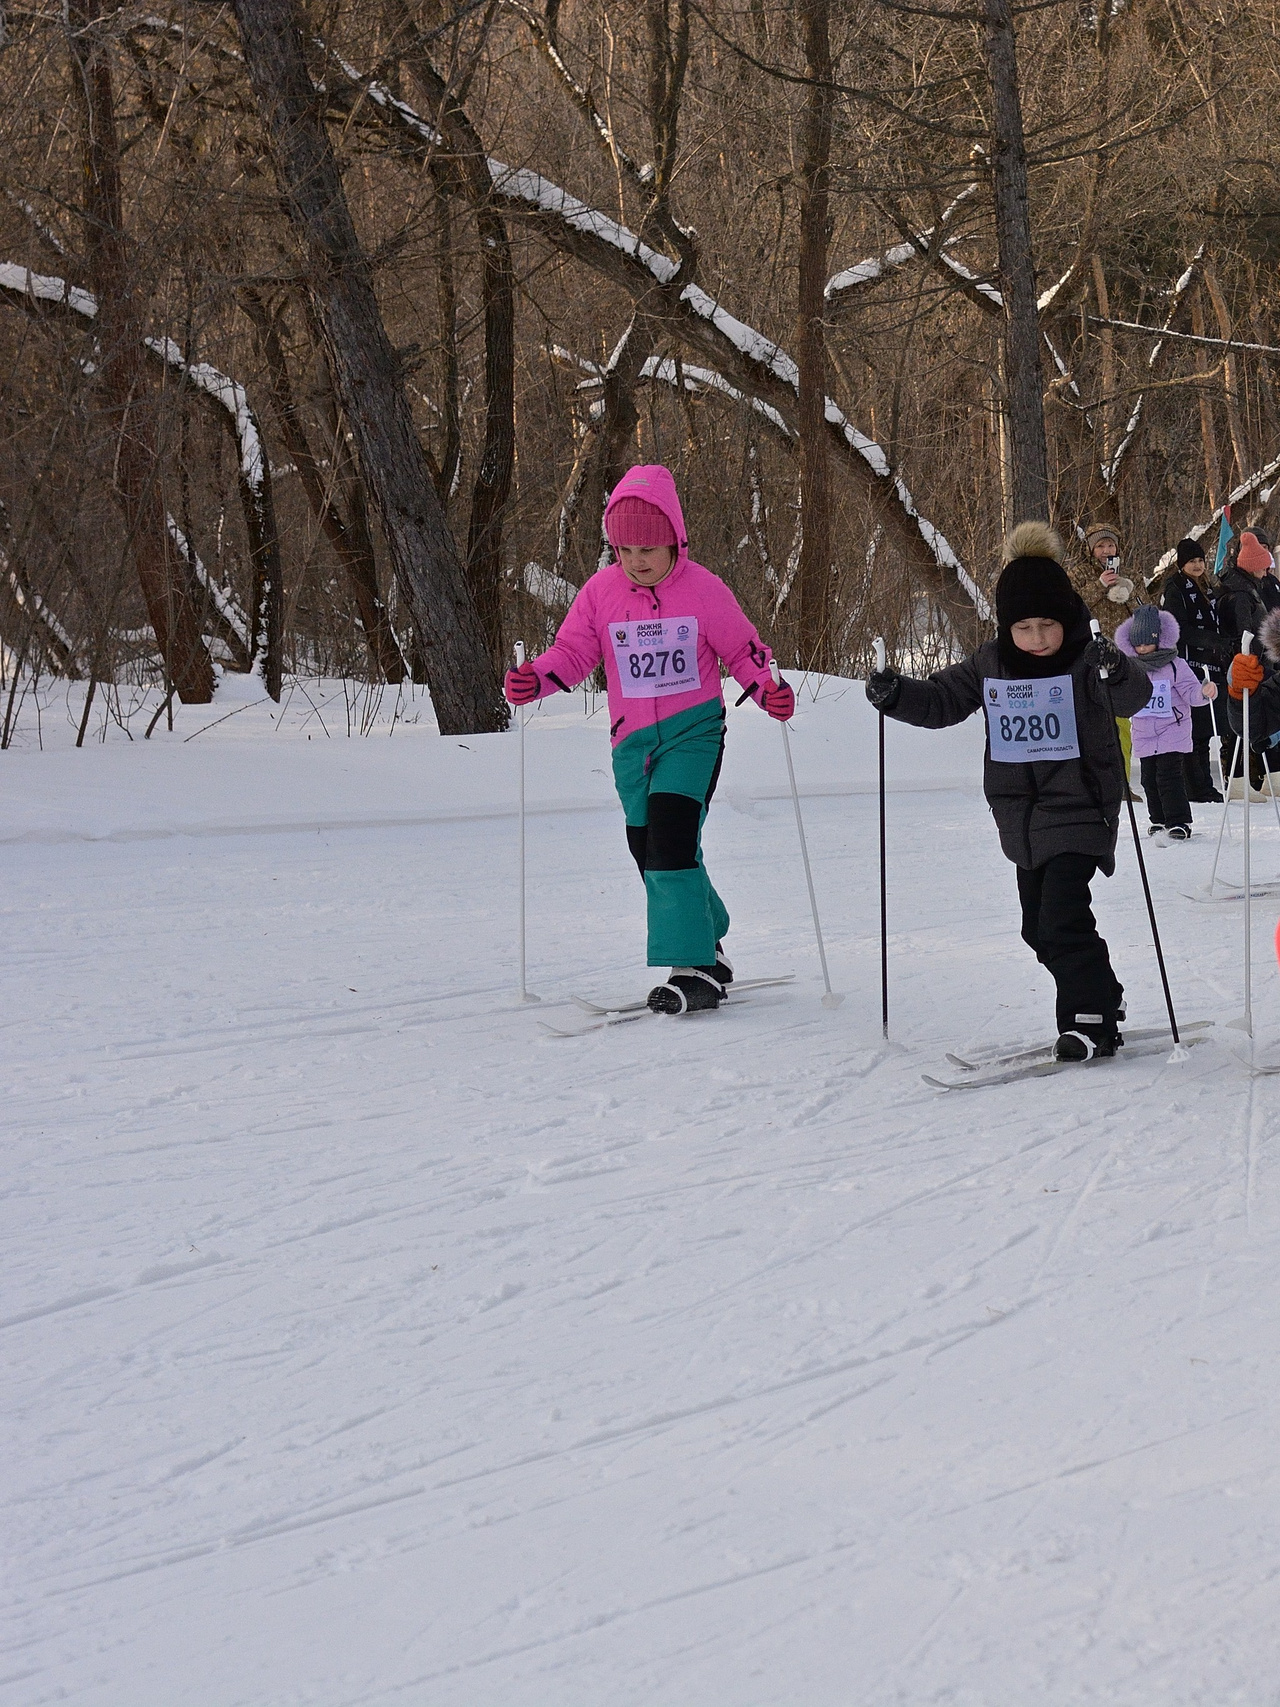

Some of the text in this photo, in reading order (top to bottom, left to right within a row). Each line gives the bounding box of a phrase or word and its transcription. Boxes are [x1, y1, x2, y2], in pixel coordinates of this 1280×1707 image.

[637, 623, 662, 631] ЛЫЖНЯ
[637, 629, 663, 638] РОССИИ
[638, 638, 664, 646] 2024
[629, 649, 686, 678] 8276
[655, 680, 679, 688] САМАРСКАЯ
[1006, 684, 1033, 692] ЛЫЖНЯ
[1008, 700, 1035, 709] 2024
[1145, 696, 1165, 709] 78
[1000, 712, 1060, 741] 8280
[1027, 746, 1053, 754] САМАРСКАЯ
